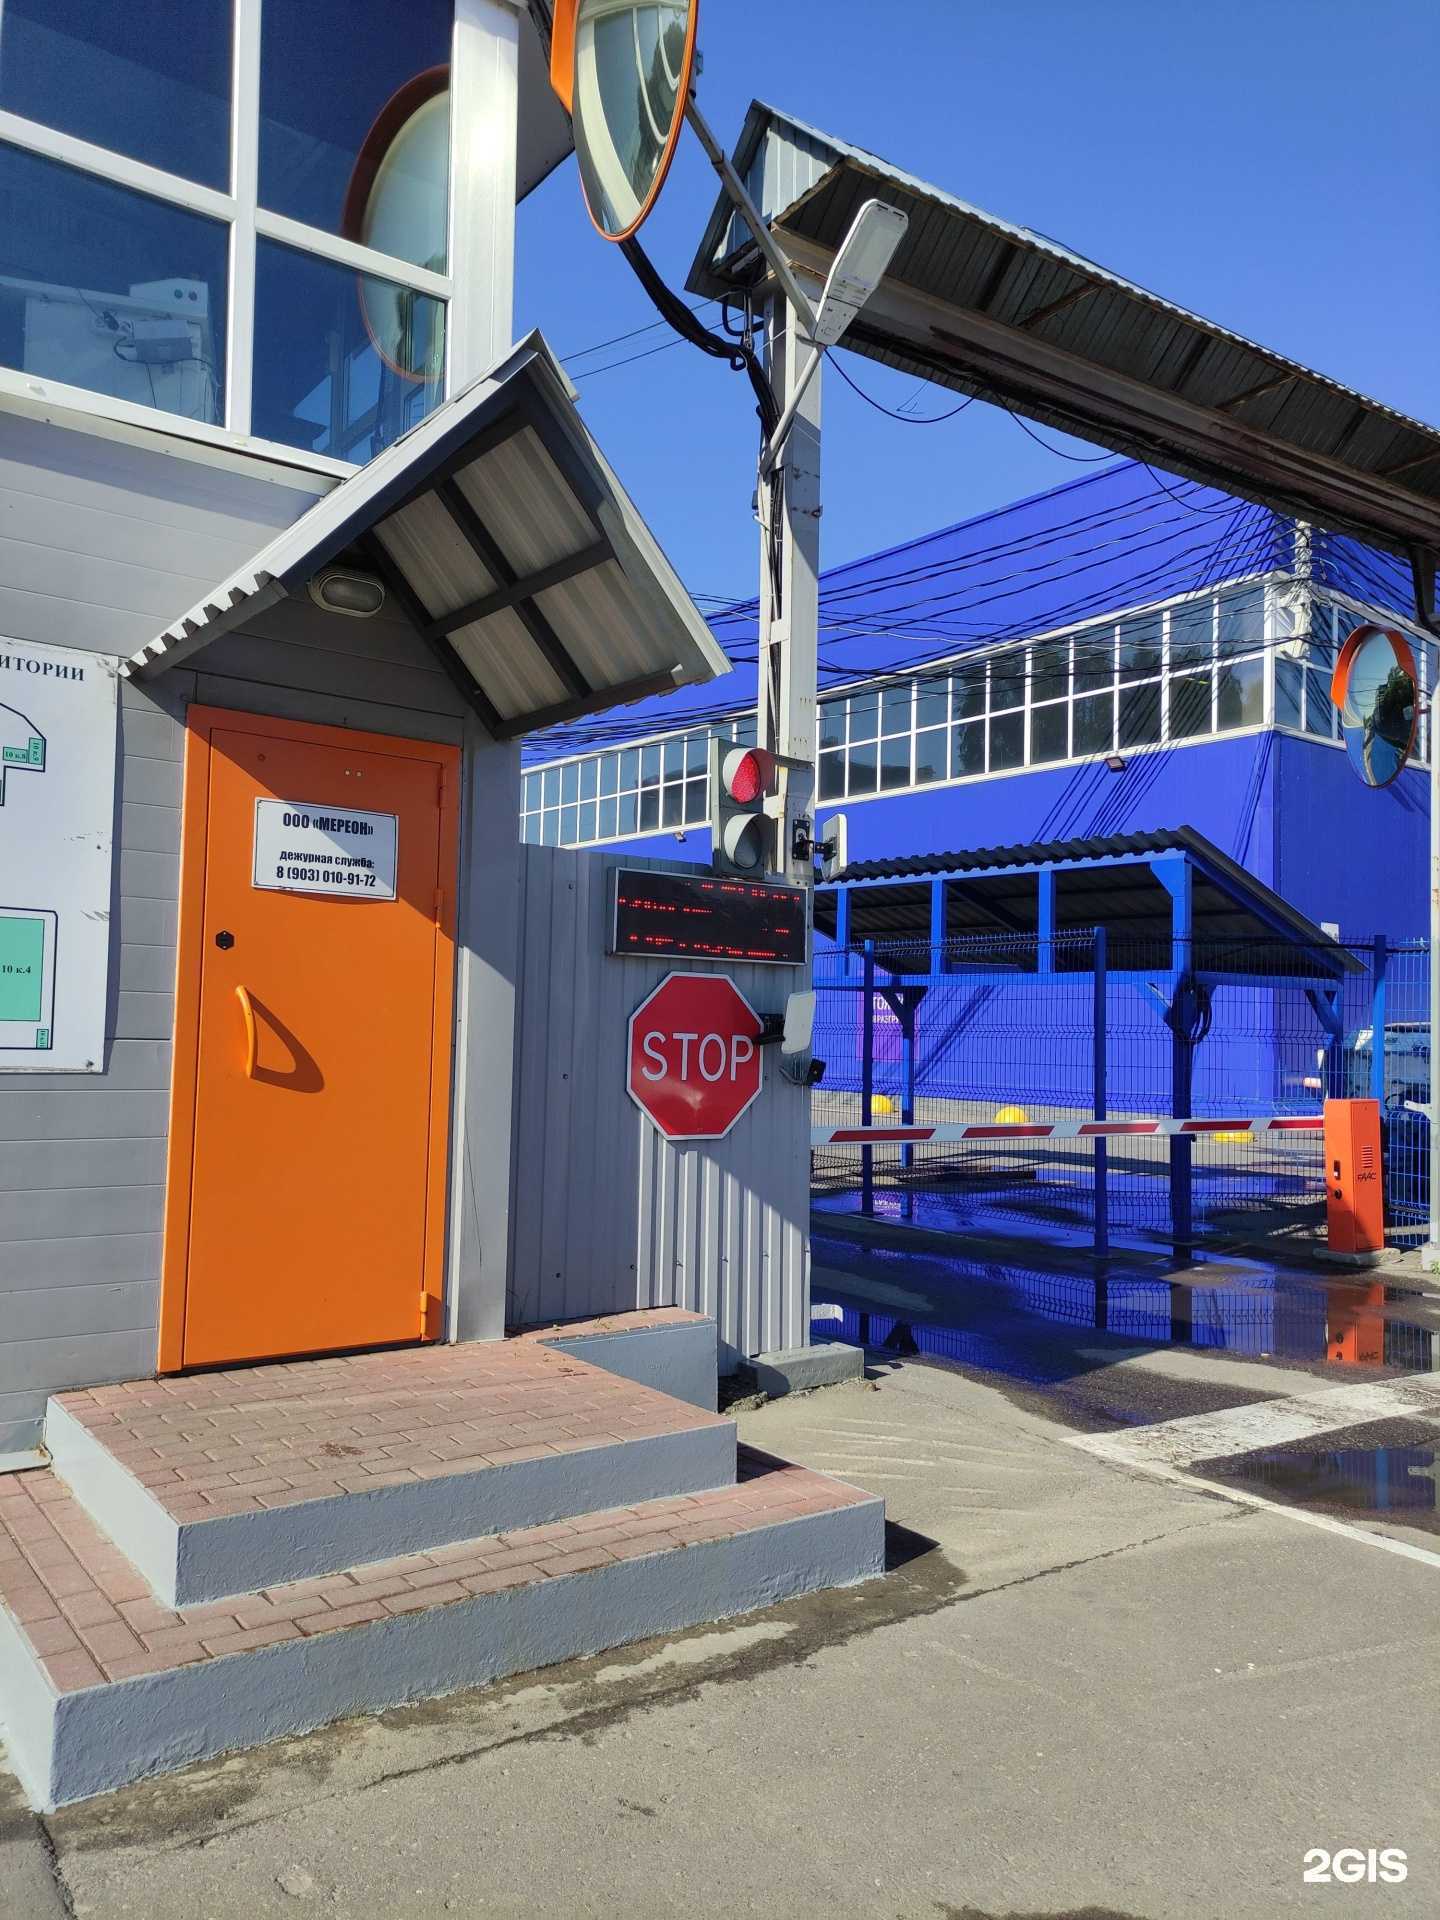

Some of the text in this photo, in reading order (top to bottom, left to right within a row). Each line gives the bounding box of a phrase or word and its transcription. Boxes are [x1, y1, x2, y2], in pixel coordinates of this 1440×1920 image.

[283, 812, 374, 836] ООО «МЕРЕОН»
[279, 850, 375, 869] дежурная служба:
[276, 866, 376, 887] 8 (903) 010-91-72
[2, 965, 31, 974] 10 к.4
[641, 1031, 754, 1082] STOP
[1357, 1171, 1377, 1182] FAAC
